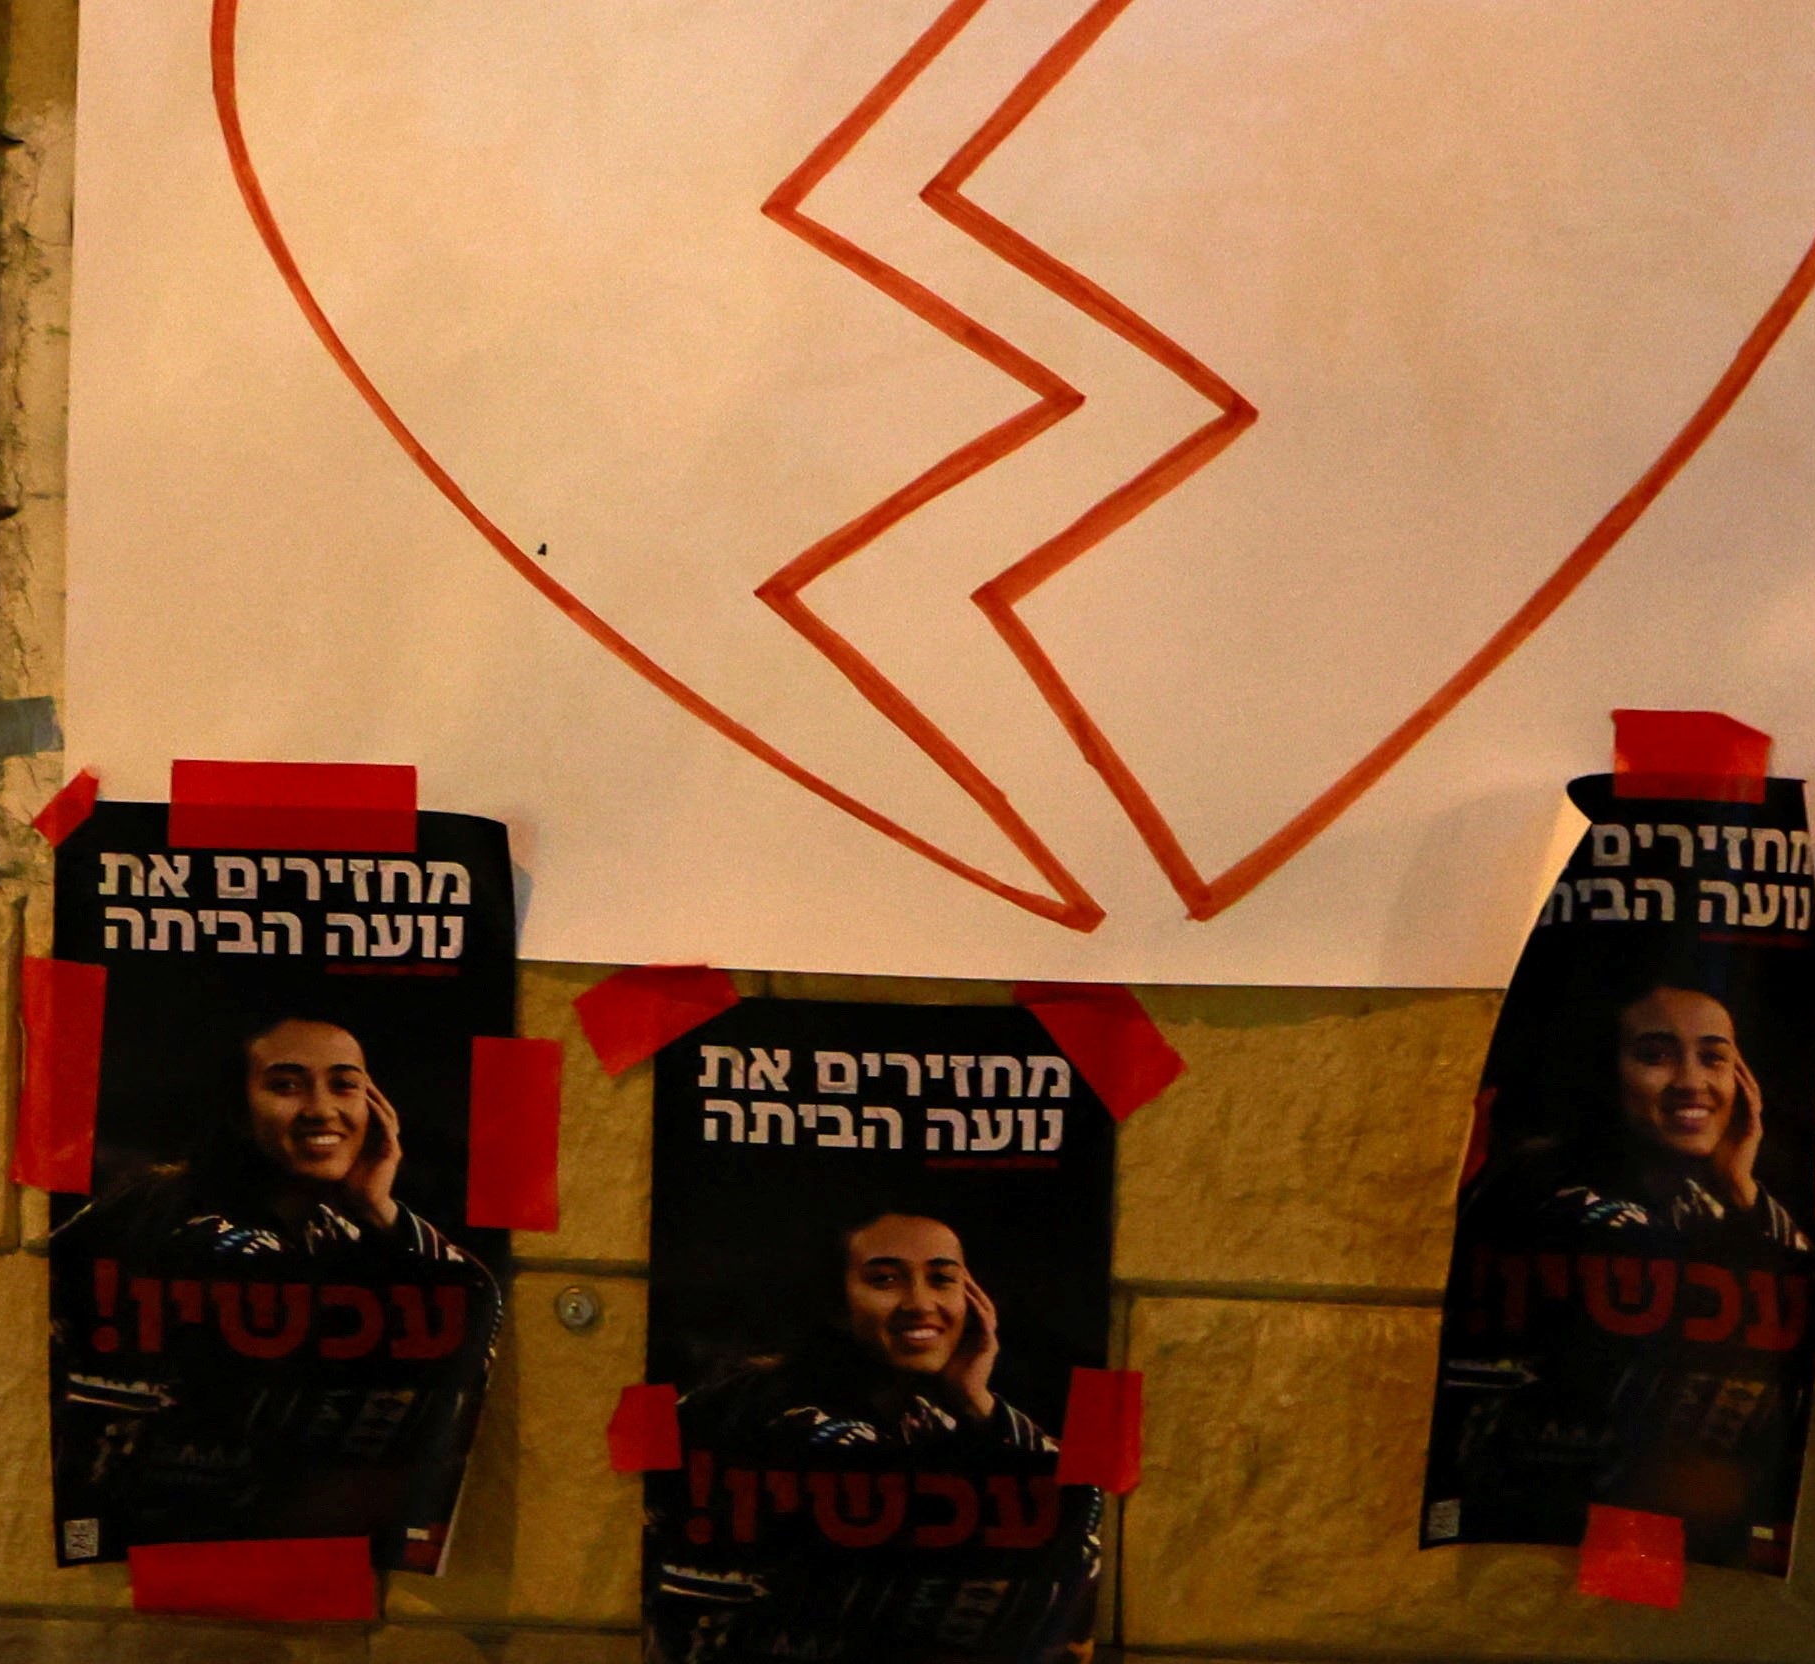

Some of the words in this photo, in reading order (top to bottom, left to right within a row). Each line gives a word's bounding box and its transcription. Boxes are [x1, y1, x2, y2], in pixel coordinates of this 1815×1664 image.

[98, 852, 191, 898] את
[213, 855, 471, 905] מחזירים
[1698, 879, 1811, 931] נועה
[104, 906, 303, 955] הביתה
[325, 912, 465, 959] נועה
[698, 1044, 791, 1092] את
[814, 1050, 1072, 1099] מחזירים
[703, 1099, 903, 1150] הביתה
[925, 1108, 1064, 1152] נועה
[94, 1258, 469, 1363] עכשיו!
[691, 1448, 1062, 1549] עכשיו!
